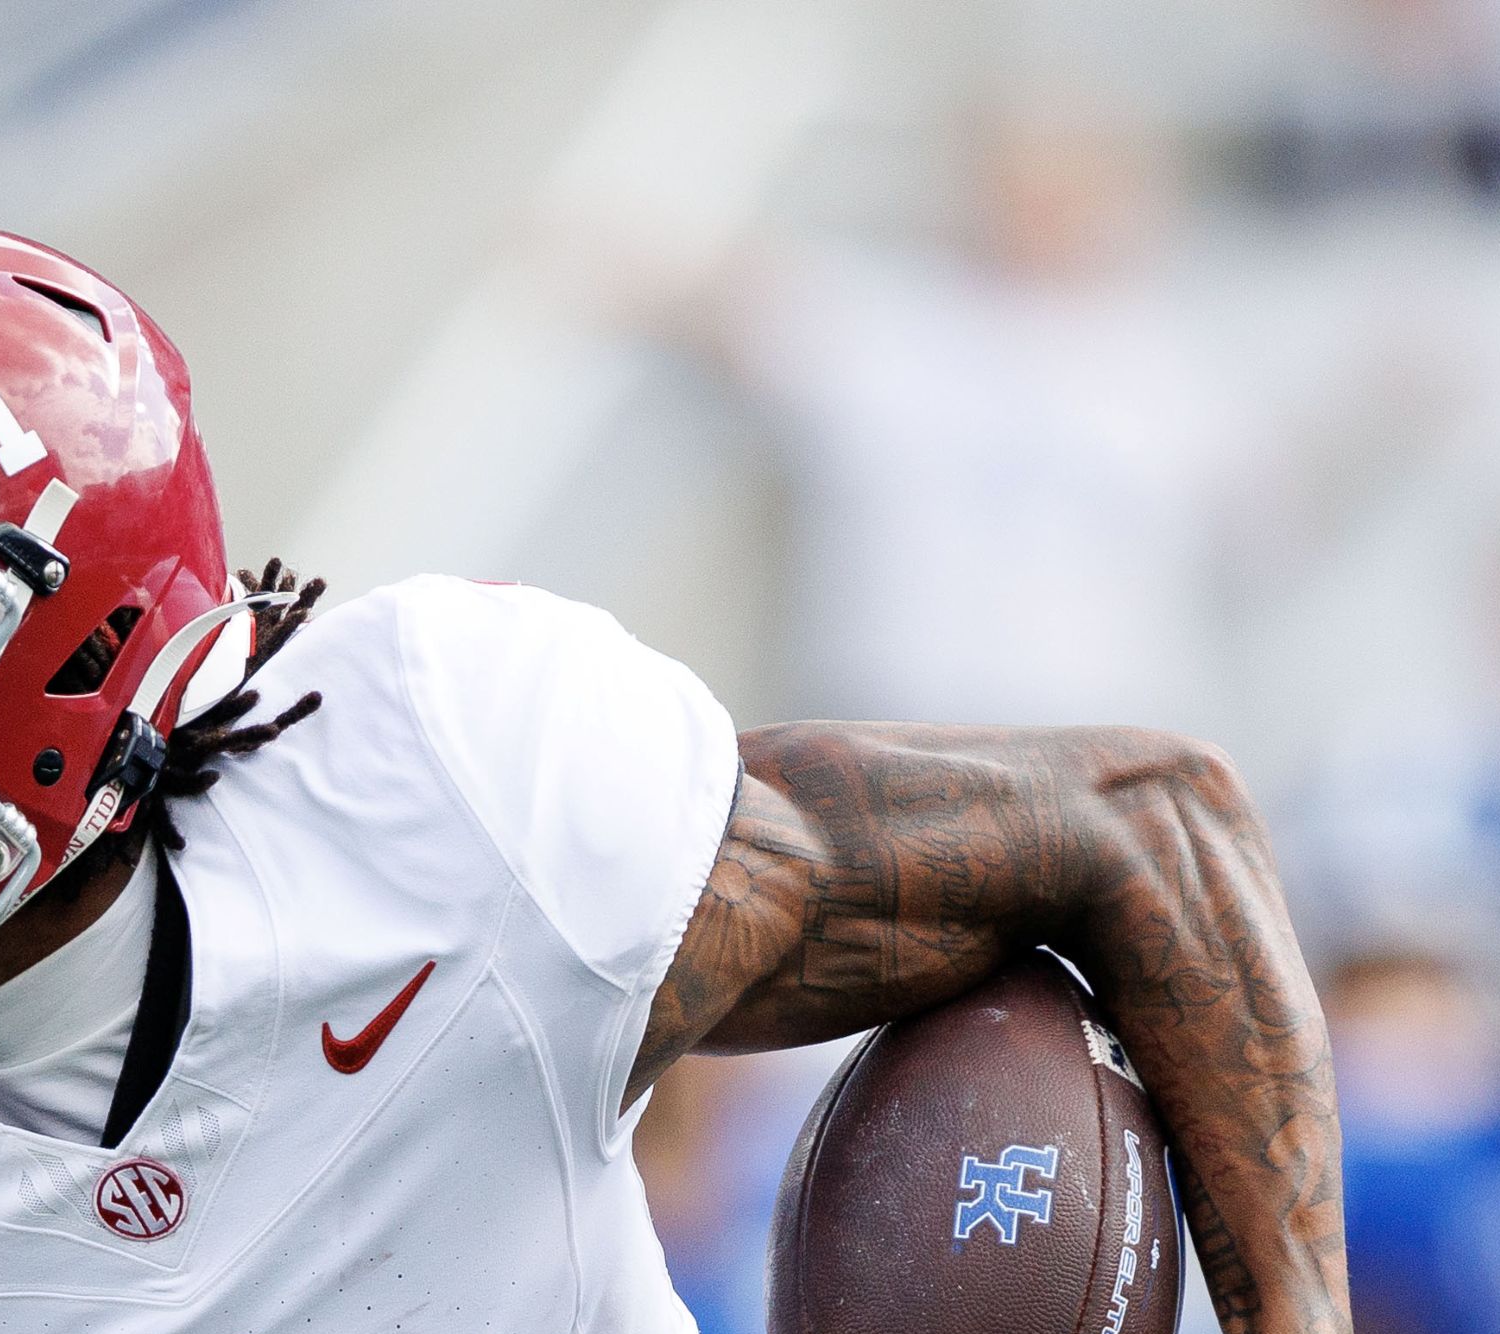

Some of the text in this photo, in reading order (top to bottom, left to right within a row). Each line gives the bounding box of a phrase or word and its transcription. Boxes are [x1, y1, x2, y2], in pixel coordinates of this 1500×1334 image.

[85, 778, 123, 833] TIDE
[99, 1163, 183, 1236] SEC
[954, 1145, 1058, 1244] UK
[1124, 1129, 1143, 1245] VAPOR
